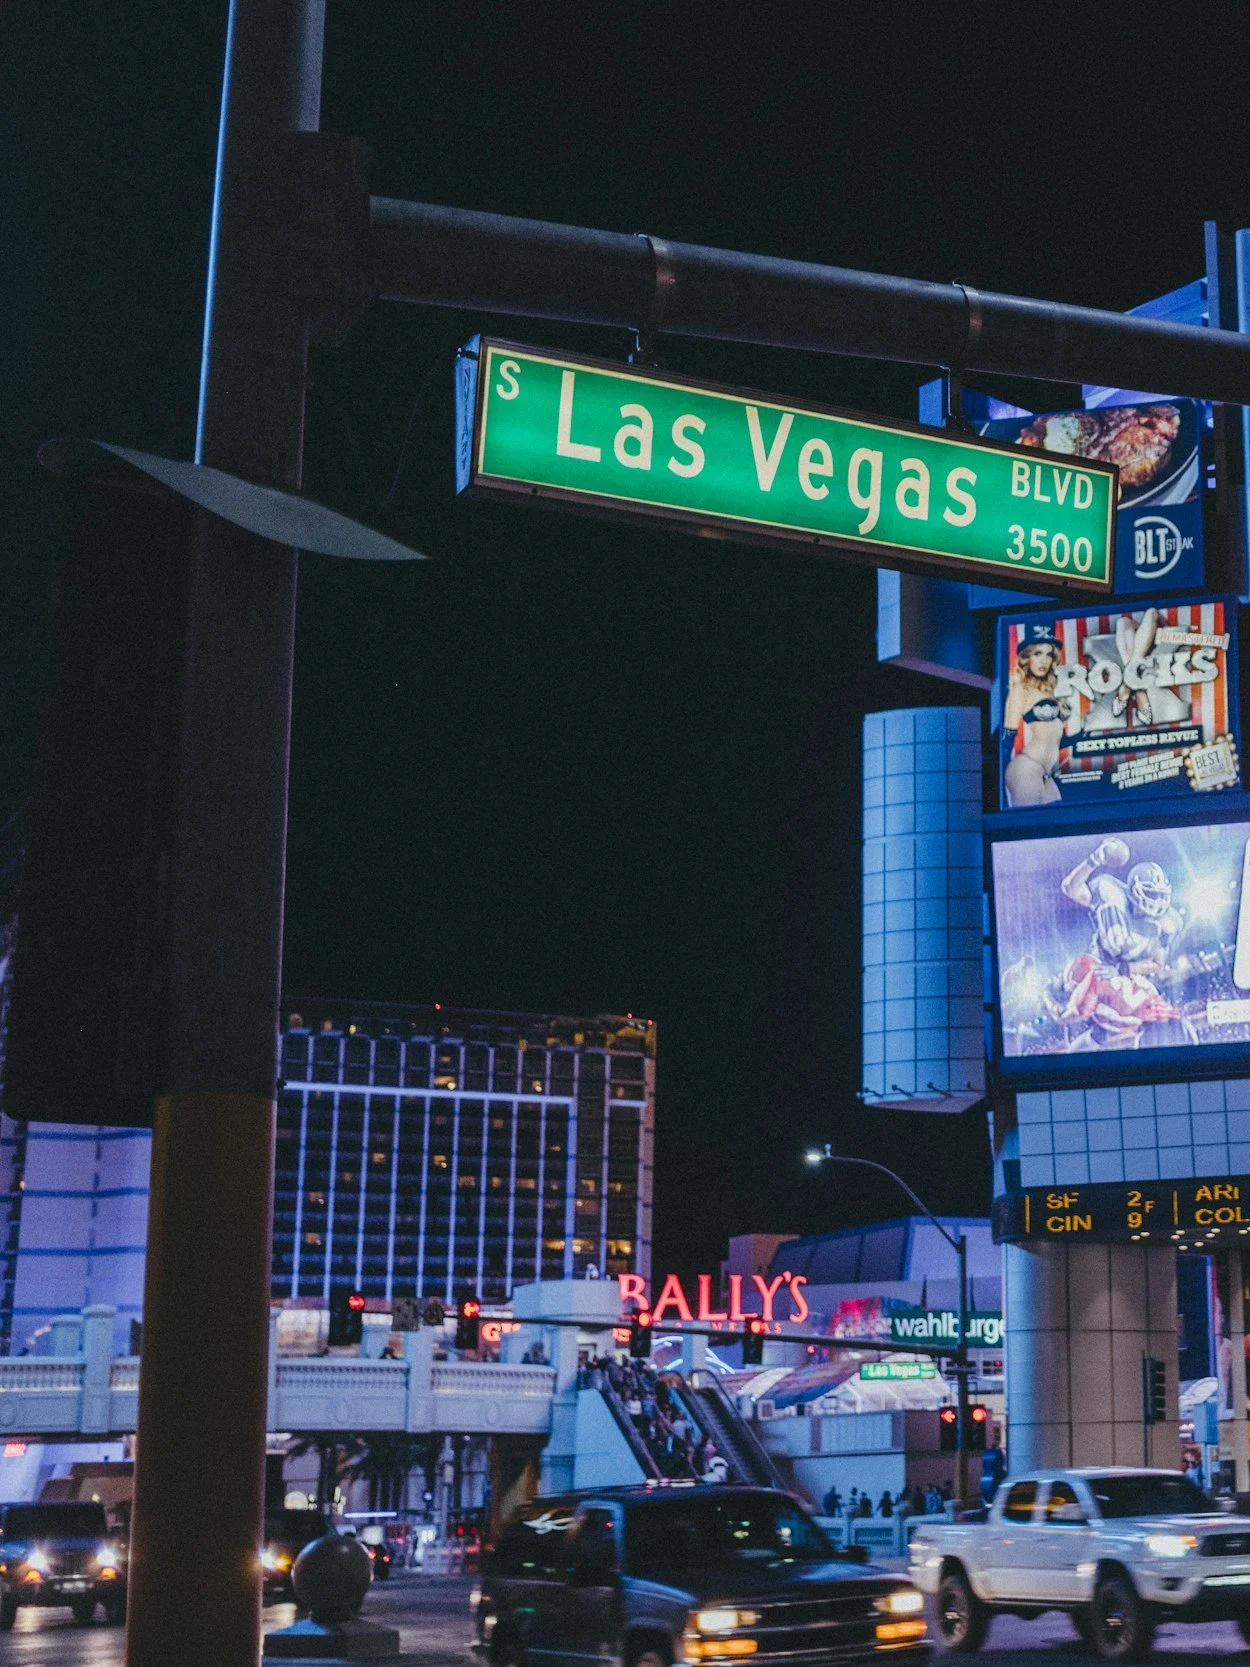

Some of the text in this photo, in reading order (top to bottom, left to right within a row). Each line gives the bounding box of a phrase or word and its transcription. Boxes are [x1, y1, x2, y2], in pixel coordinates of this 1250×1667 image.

[497, 360, 1094, 534] S Las Vegas BLVD
[1005, 523, 1093, 573] 3500
[1135, 528, 1169, 565] BLT
[1054, 646, 1219, 700] ROCKS
[1076, 729, 1199, 752] SEXY TOPLESS REVUE
[1195, 751, 1220, 769] BEST
[1046, 1192, 1079, 1209] SF
[1127, 1191, 1142, 1207] 2
[1194, 1184, 1240, 1201] ARI
[1046, 1213, 1142, 1232] CIN 9
[1194, 1205, 1250, 1225] COL
[618, 1270, 809, 1323] BALLY'S
